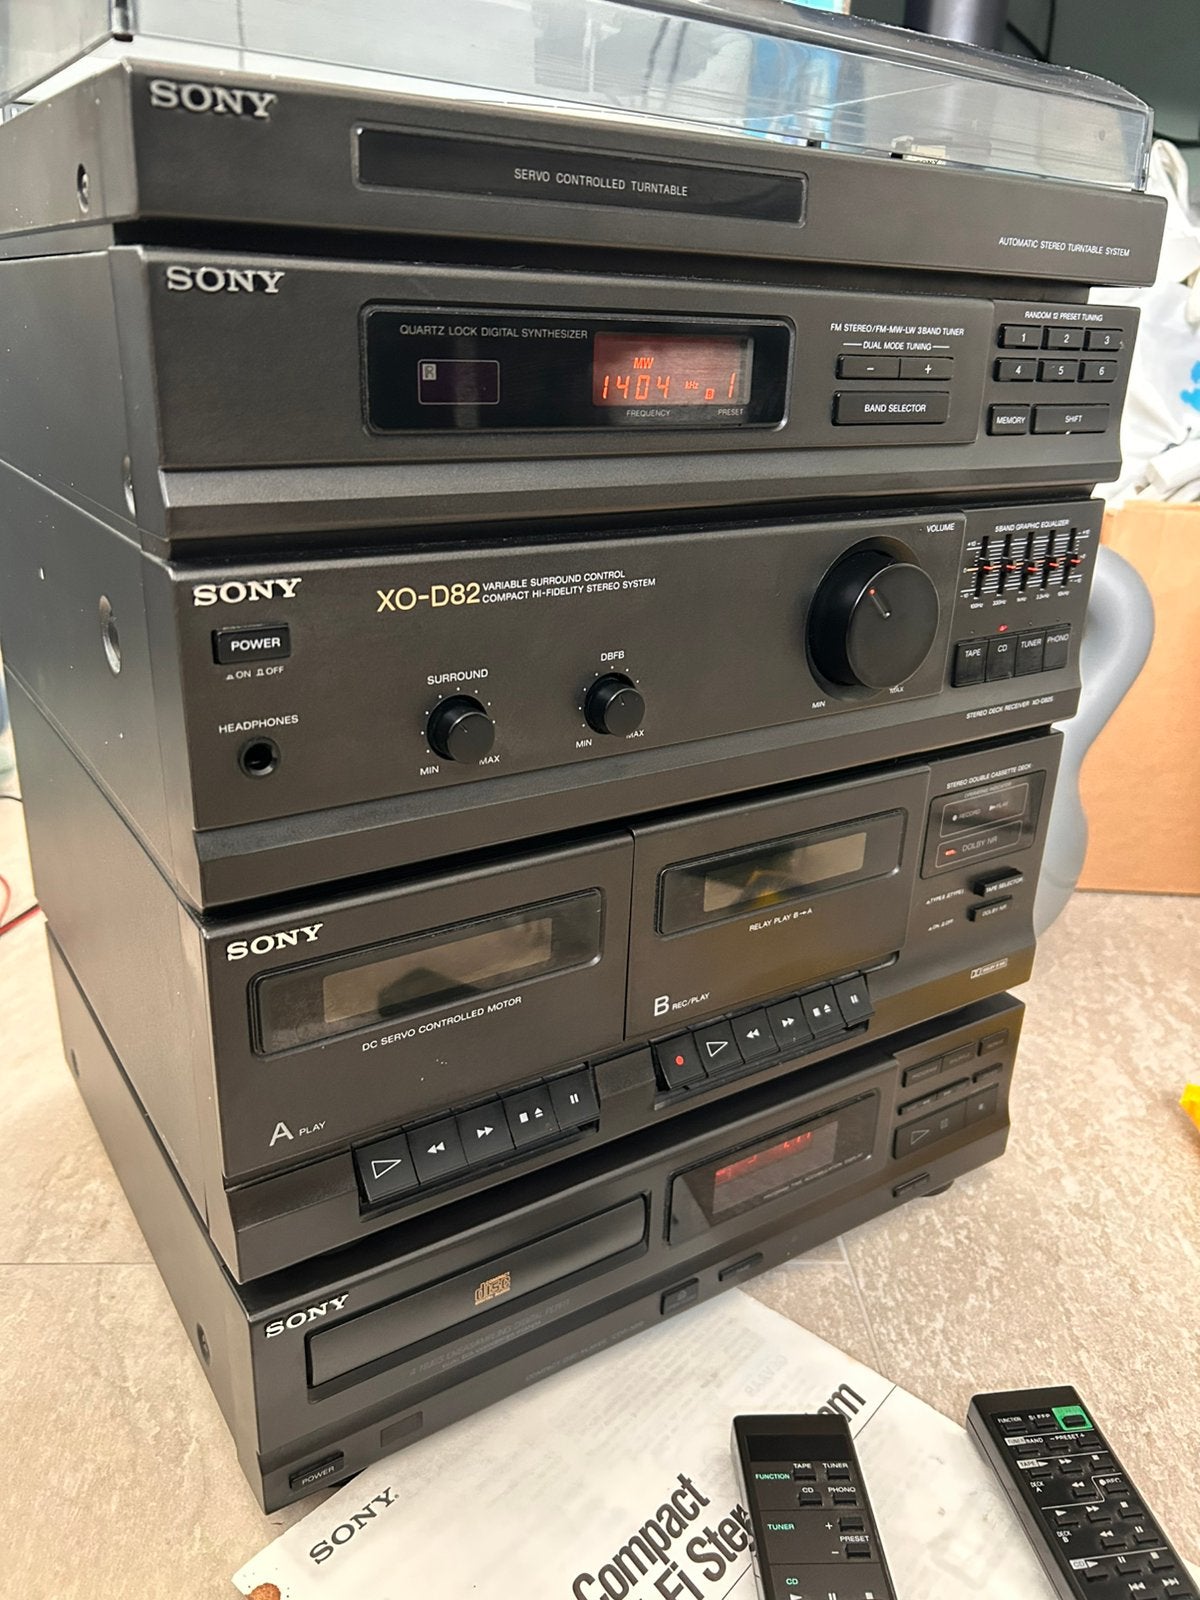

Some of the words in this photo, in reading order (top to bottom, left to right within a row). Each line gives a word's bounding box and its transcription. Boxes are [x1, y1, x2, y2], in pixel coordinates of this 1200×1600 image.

[150, 79, 278, 119] SONY
[514, 168, 550, 182] SERVO
[556, 172, 625, 190] CONTROLLED
[631, 181, 688, 196] TURNTABLE
[999, 237, 1039, 248] AUTOMATIC
[1040, 240, 1066, 251] STEREO
[1068, 243, 1104, 254] TURNTABLE
[1105, 247, 1130, 257] SYSTEM
[166, 266, 285, 294] SONY
[1025, 311, 1051, 319] RANDOM
[1060, 312, 1081, 320] PRESET
[1082, 313, 1104, 321] TUNING
[400, 325, 445, 336] QUARTZ
[449, 326, 477, 336] LOCK
[481, 327, 519, 338] DIGITAL
[522, 328, 588, 339] SYNTHESIZER
[830, 323, 841, 331] FM
[843, 323, 916, 335] STEREO/FM-MW-LW
[942, 327, 965, 336] TUNER
[1021, 333, 1026, 342] 1
[1064, 334, 1069, 343] 2
[1104, 336, 1110, 345] 3
[863, 341, 882, 349] DUAL
[883, 341, 904, 350] MODE
[906, 342, 932, 351] TUNING
[634, 357, 654, 369] MW
[1015, 366, 1021, 374] 4
[1058, 366, 1064, 375] 5
[1099, 367, 1104, 375] 6
[602, 375, 671, 400] 1404
[685, 380, 700, 390] kHz
[728, 372, 736, 399] 1
[627, 409, 670, 417] FREQUENCY
[718, 408, 743, 416] PRESET
[864, 404, 886, 413] BAND
[888, 404, 927, 413] SELECTOR
[996, 416, 1025, 424] MEMORY
[1065, 415, 1083, 423] SHIFT
[926, 522, 955, 533] VOLUME
[1016, 521, 1039, 530] GRAPHIC
[1041, 519, 1070, 528] EQUALIZER
[482, 579, 528, 591] VARIABLE
[530, 574, 582, 587] SURROUND
[583, 570, 625, 581] CONTROL
[193, 577, 303, 606] SONY
[376, 582, 480, 612] XO-D82
[482, 590, 529, 603] COMPACT
[532, 585, 584, 598] HI-FIDELITY
[587, 582, 620, 592] STEREO
[622, 578, 656, 589] SYSTEM
[231, 637, 281, 651] POWER
[965, 648, 981, 657] TAPE
[997, 644, 1008, 652] CD
[1021, 639, 1042, 648] TUNER
[1046, 634, 1069, 643] PHONO
[600, 650, 625, 661] DBFB
[236, 670, 251, 679] ON
[266, 666, 284, 675] OFF
[427, 668, 489, 686] SURROUND
[812, 700, 826, 709] MIN
[966, 709, 987, 720] STEREO
[988, 706, 1003, 715] DECK
[1004, 701, 1030, 711] RECEIVER
[218, 715, 299, 734] HEADPHONES
[575, 739, 592, 748] MIN
[420, 765, 439, 775] MIN
[946, 779, 968, 789] STEREO
[968, 773, 990, 784] DOUBLE
[991, 767, 1017, 778] CASSETTE
[1017, 763, 1032, 771] DECK
[962, 840, 984, 852] DOLBY
[987, 835, 997, 844] NR
[749, 919, 772, 931] RELAY
[774, 913, 791, 924] PLAY
[227, 923, 323, 962] SONY
[653, 995, 670, 1017] B
[672, 992, 710, 1011] REC/PLAY
[362, 1040, 378, 1052] DC
[380, 1029, 416, 1046] SERVO
[418, 1007, 485, 1033] CONTROLLED
[487, 996, 522, 1014] MOTOR
[269, 1121, 294, 1147] A
[299, 1121, 327, 1136] PLAY
[266, 1292, 349, 1338] SONY
[301, 1465, 335, 1485] POWER
[309, 1486, 396, 1565] SONY
[572, 1473, 711, 1600] Compact
